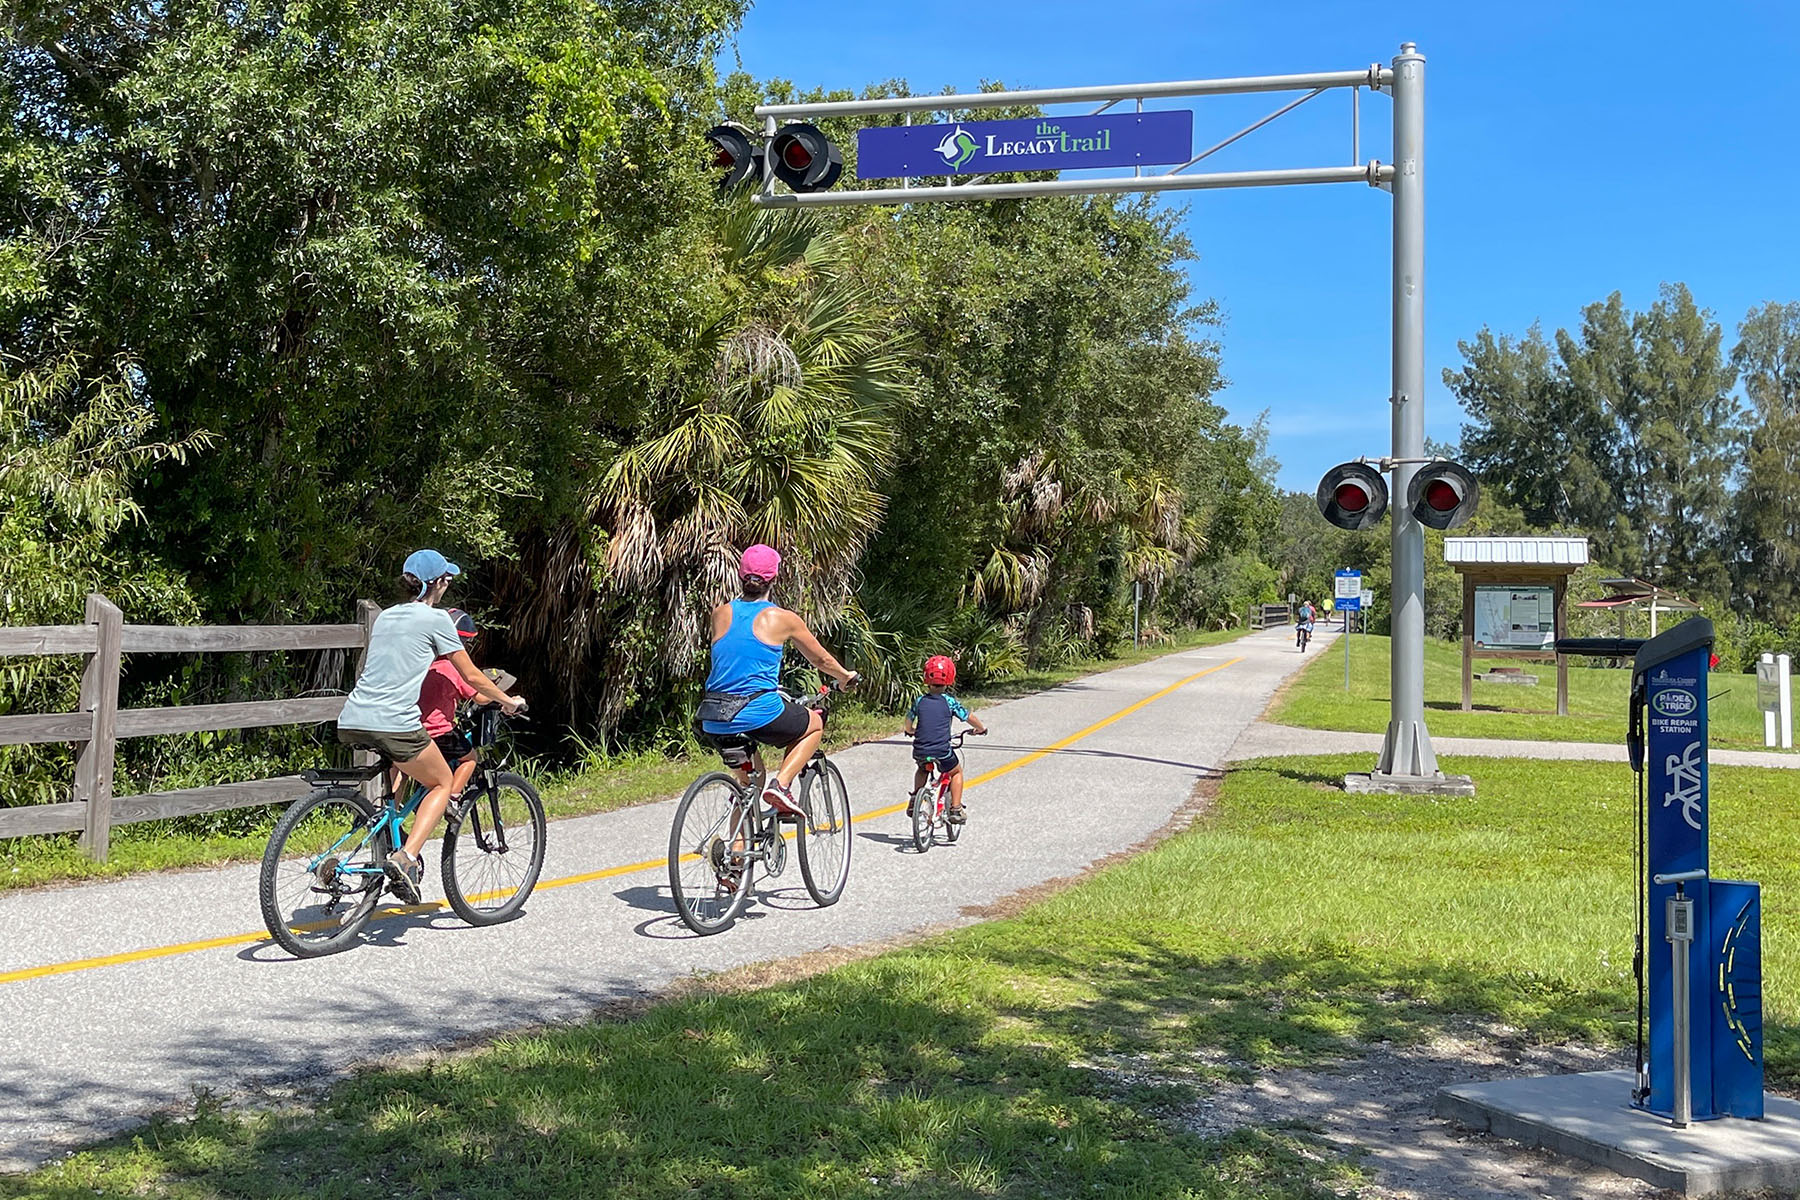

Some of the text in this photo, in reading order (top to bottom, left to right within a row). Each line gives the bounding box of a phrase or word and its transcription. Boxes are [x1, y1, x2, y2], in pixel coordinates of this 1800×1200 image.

[1036, 121, 1060, 135] the
[984, 129, 1111, 157] LEGACY trail
[1659, 702, 1691, 711] STRIDE
[1652, 718, 1698, 727] BIKE REPAIR
[1660, 726, 1692, 734] STATION
